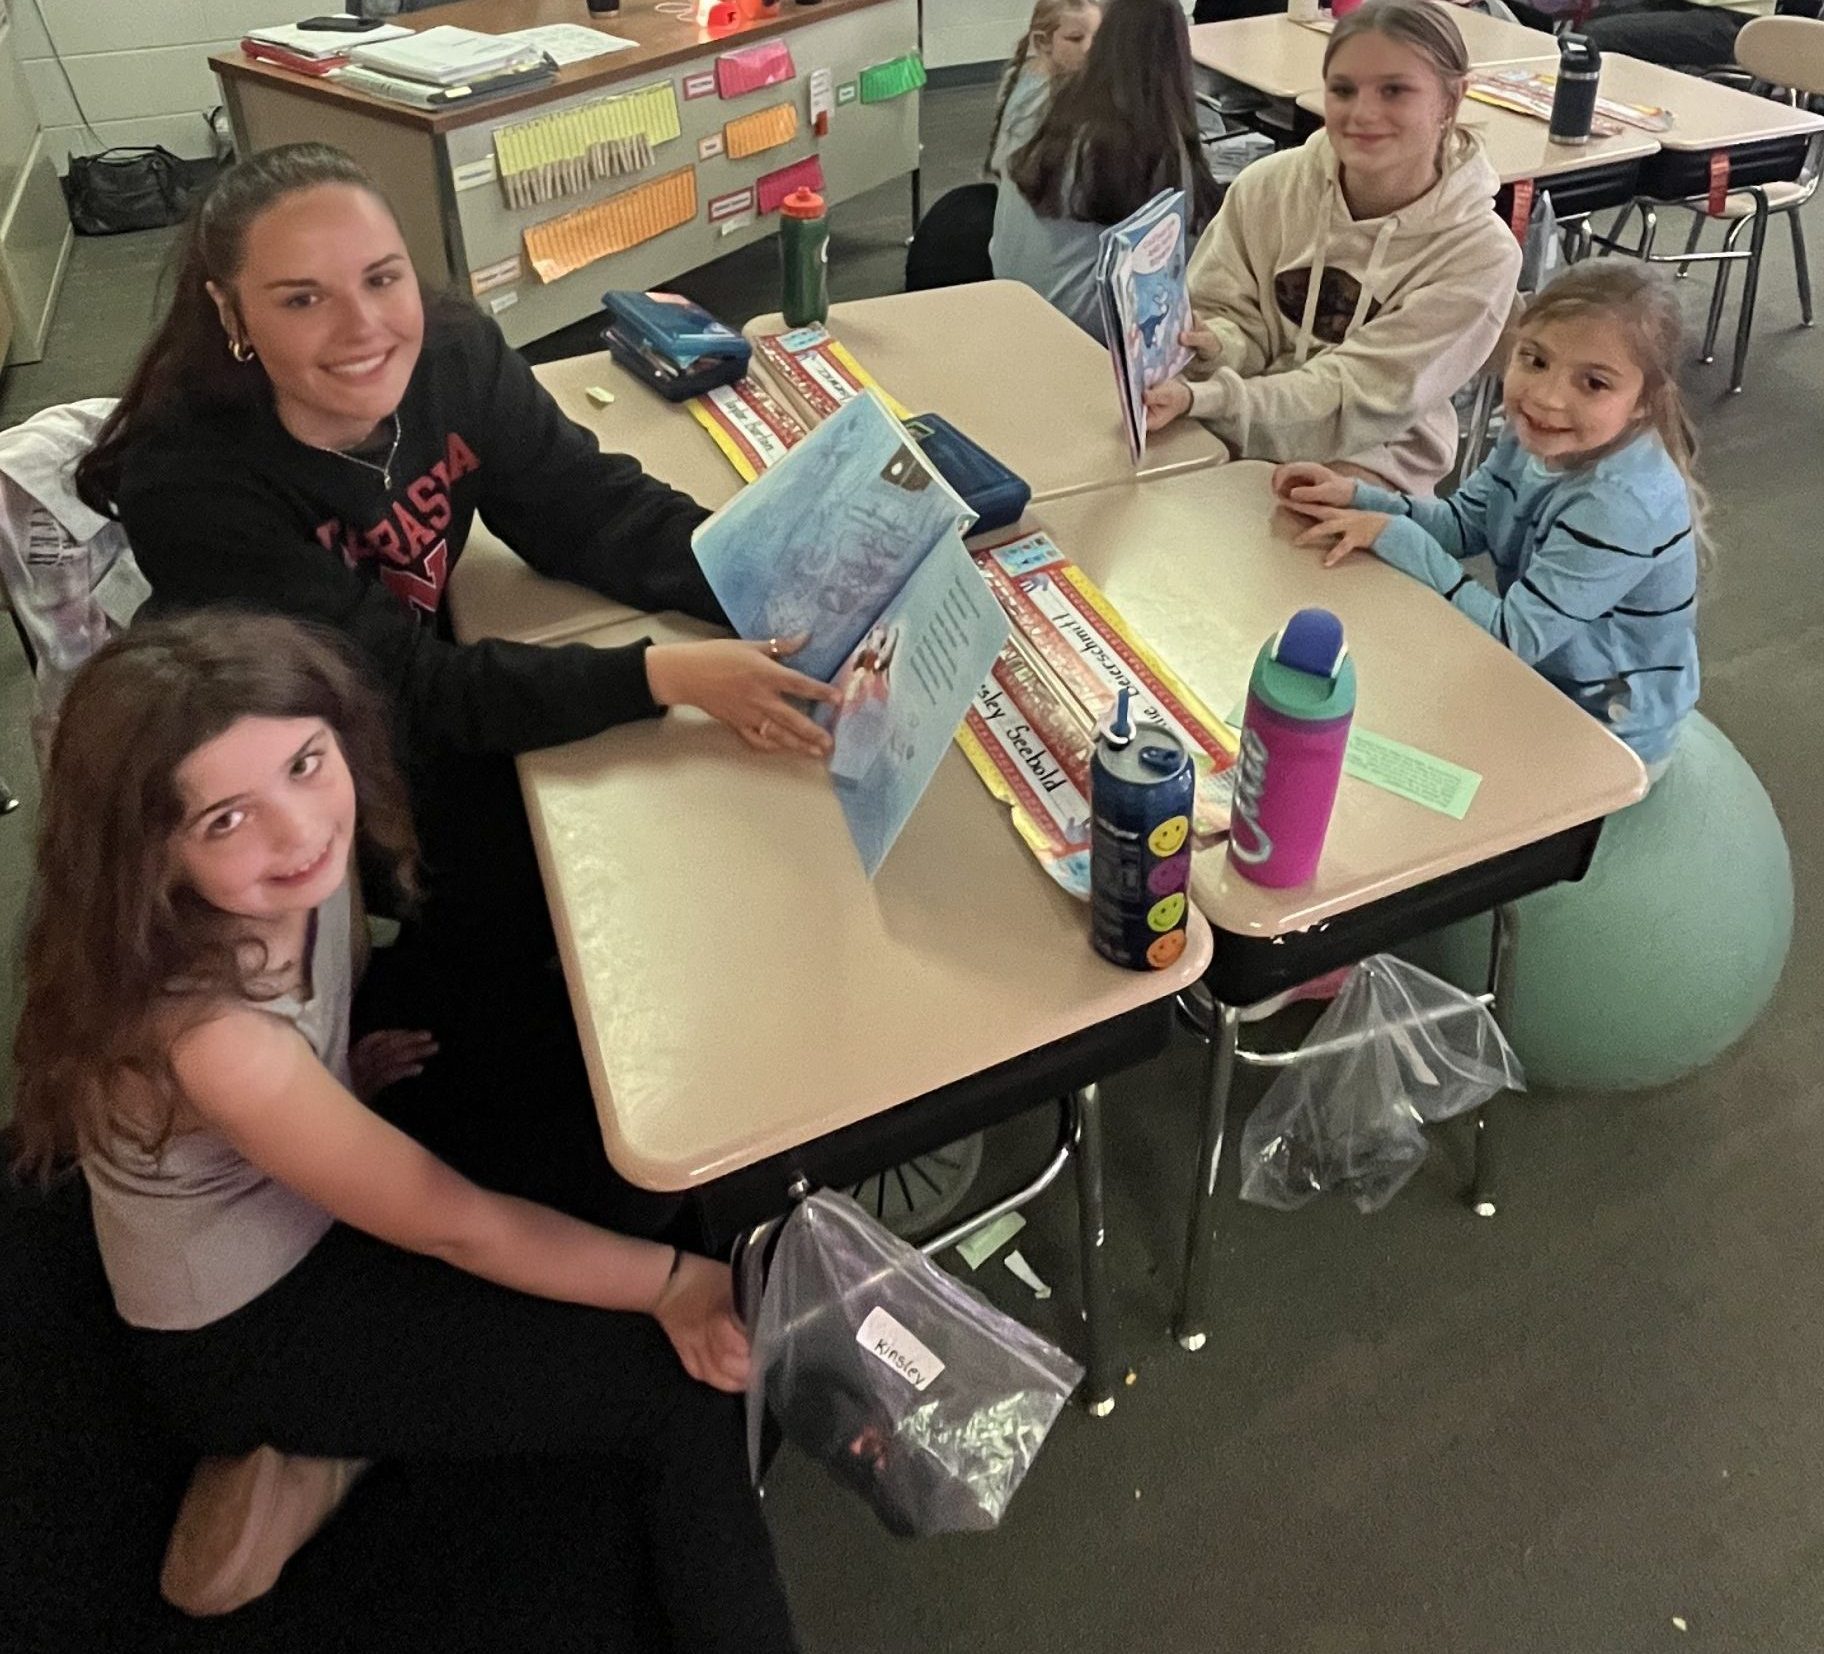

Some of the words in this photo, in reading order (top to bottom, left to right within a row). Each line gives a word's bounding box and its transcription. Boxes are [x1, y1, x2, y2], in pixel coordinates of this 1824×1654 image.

[977, 683, 1006, 721] sley
[1006, 724, 1068, 793] Seebold
[873, 1337, 926, 1386] Kinsley
